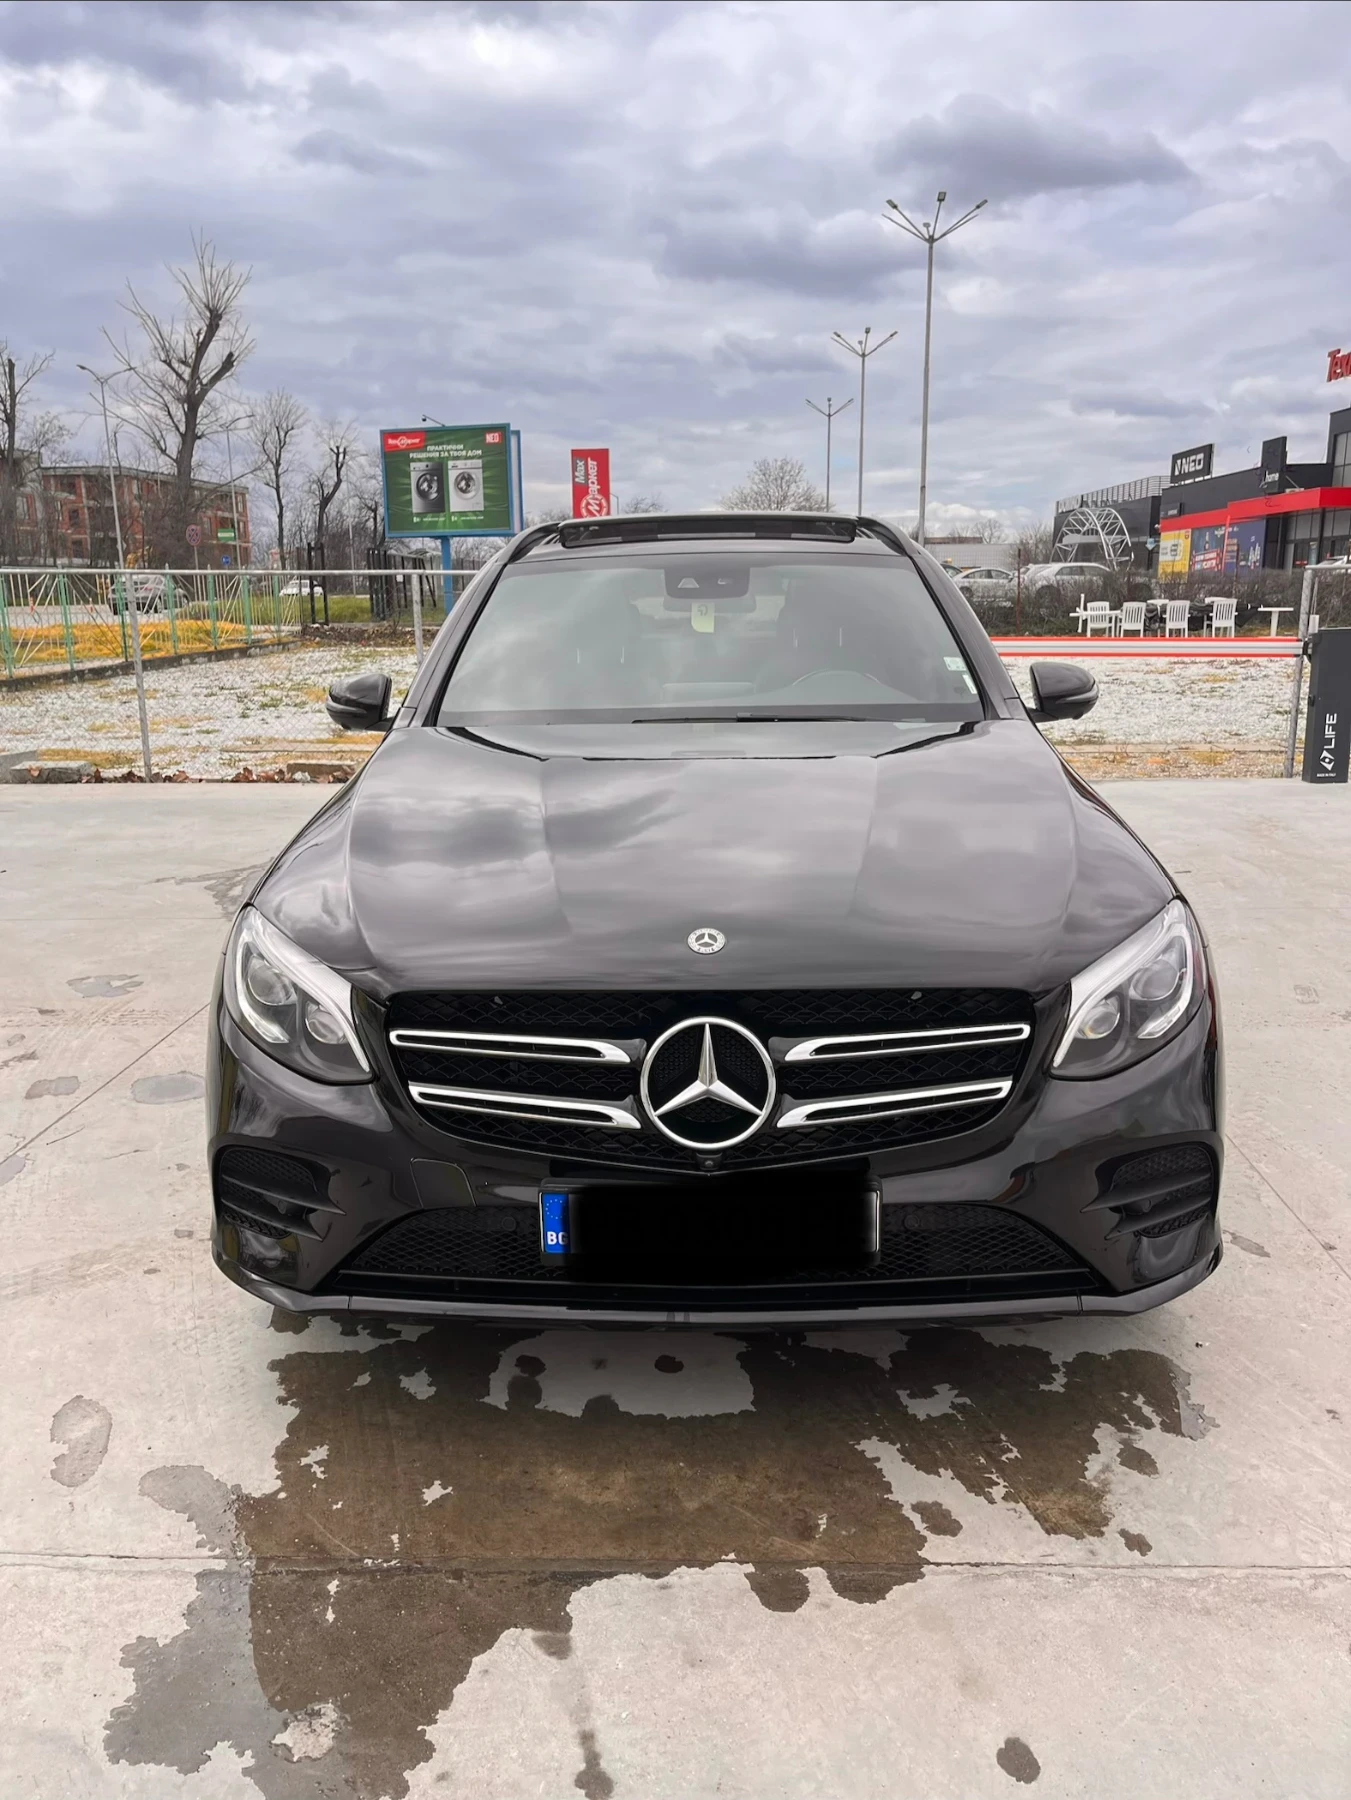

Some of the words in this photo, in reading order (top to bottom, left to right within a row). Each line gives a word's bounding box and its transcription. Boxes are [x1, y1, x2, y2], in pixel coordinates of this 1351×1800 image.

[467, 449, 482, 457] ДОМ
[1181, 453, 1204, 474] NEO
[575, 459, 585, 484] Max
[1324, 713, 1337, 749] LIFE
[547, 1231, 569, 1245] BG
